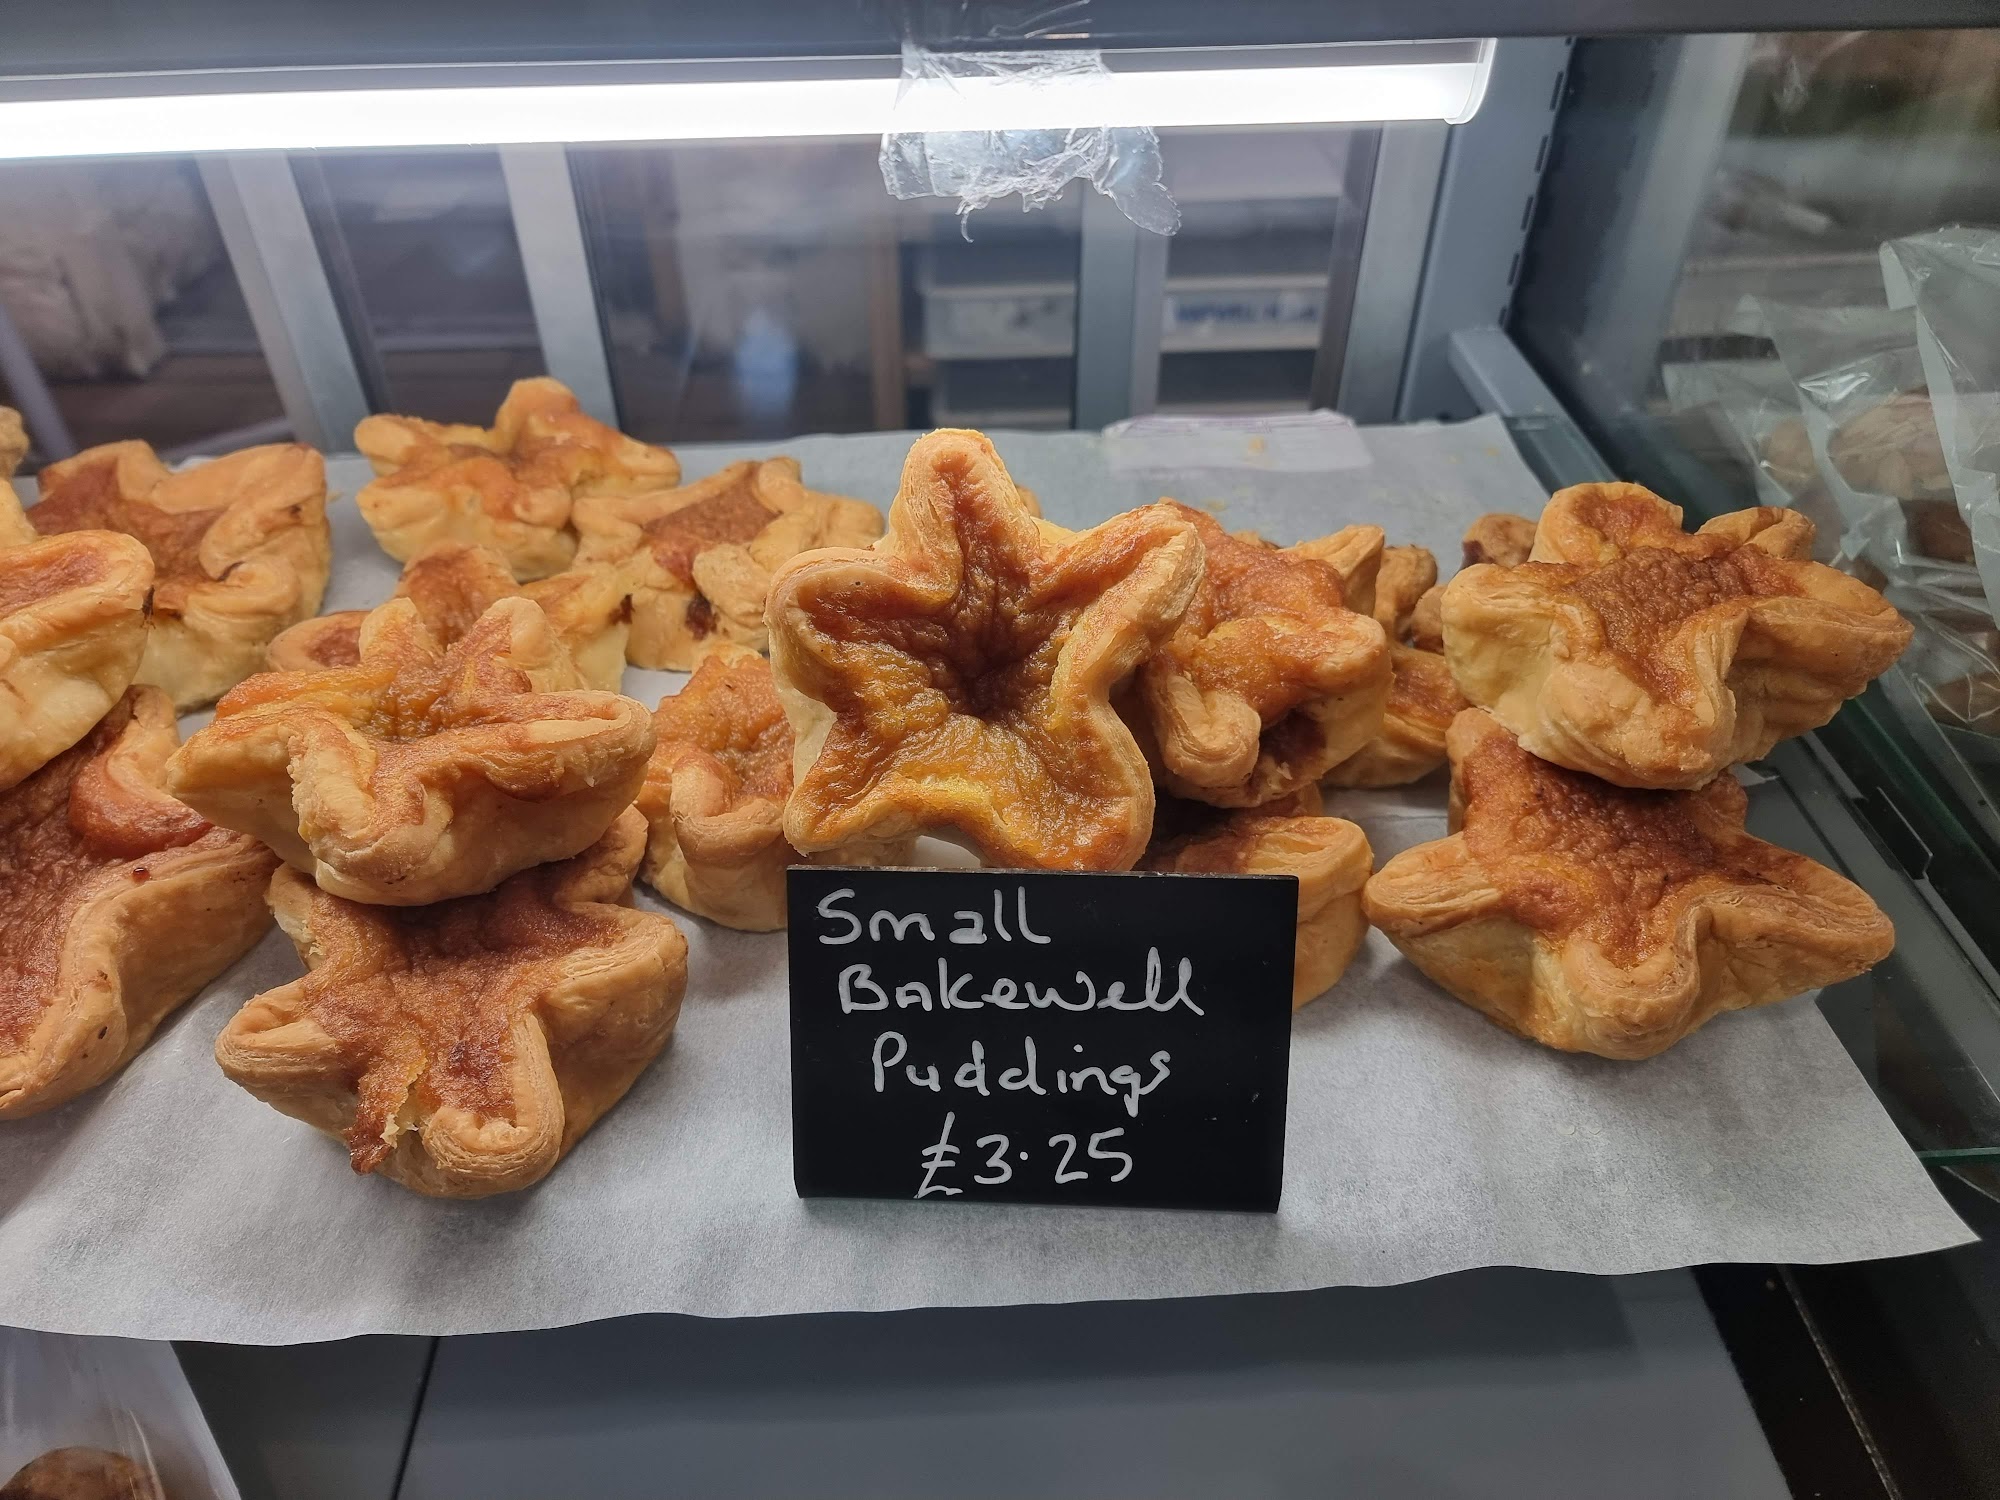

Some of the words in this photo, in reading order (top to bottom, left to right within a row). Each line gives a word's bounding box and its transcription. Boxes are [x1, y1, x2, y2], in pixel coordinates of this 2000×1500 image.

[817, 887, 1051, 945] Small
[838, 946, 1205, 1016] Bakewell
[872, 1031, 1171, 1118] Puddings
